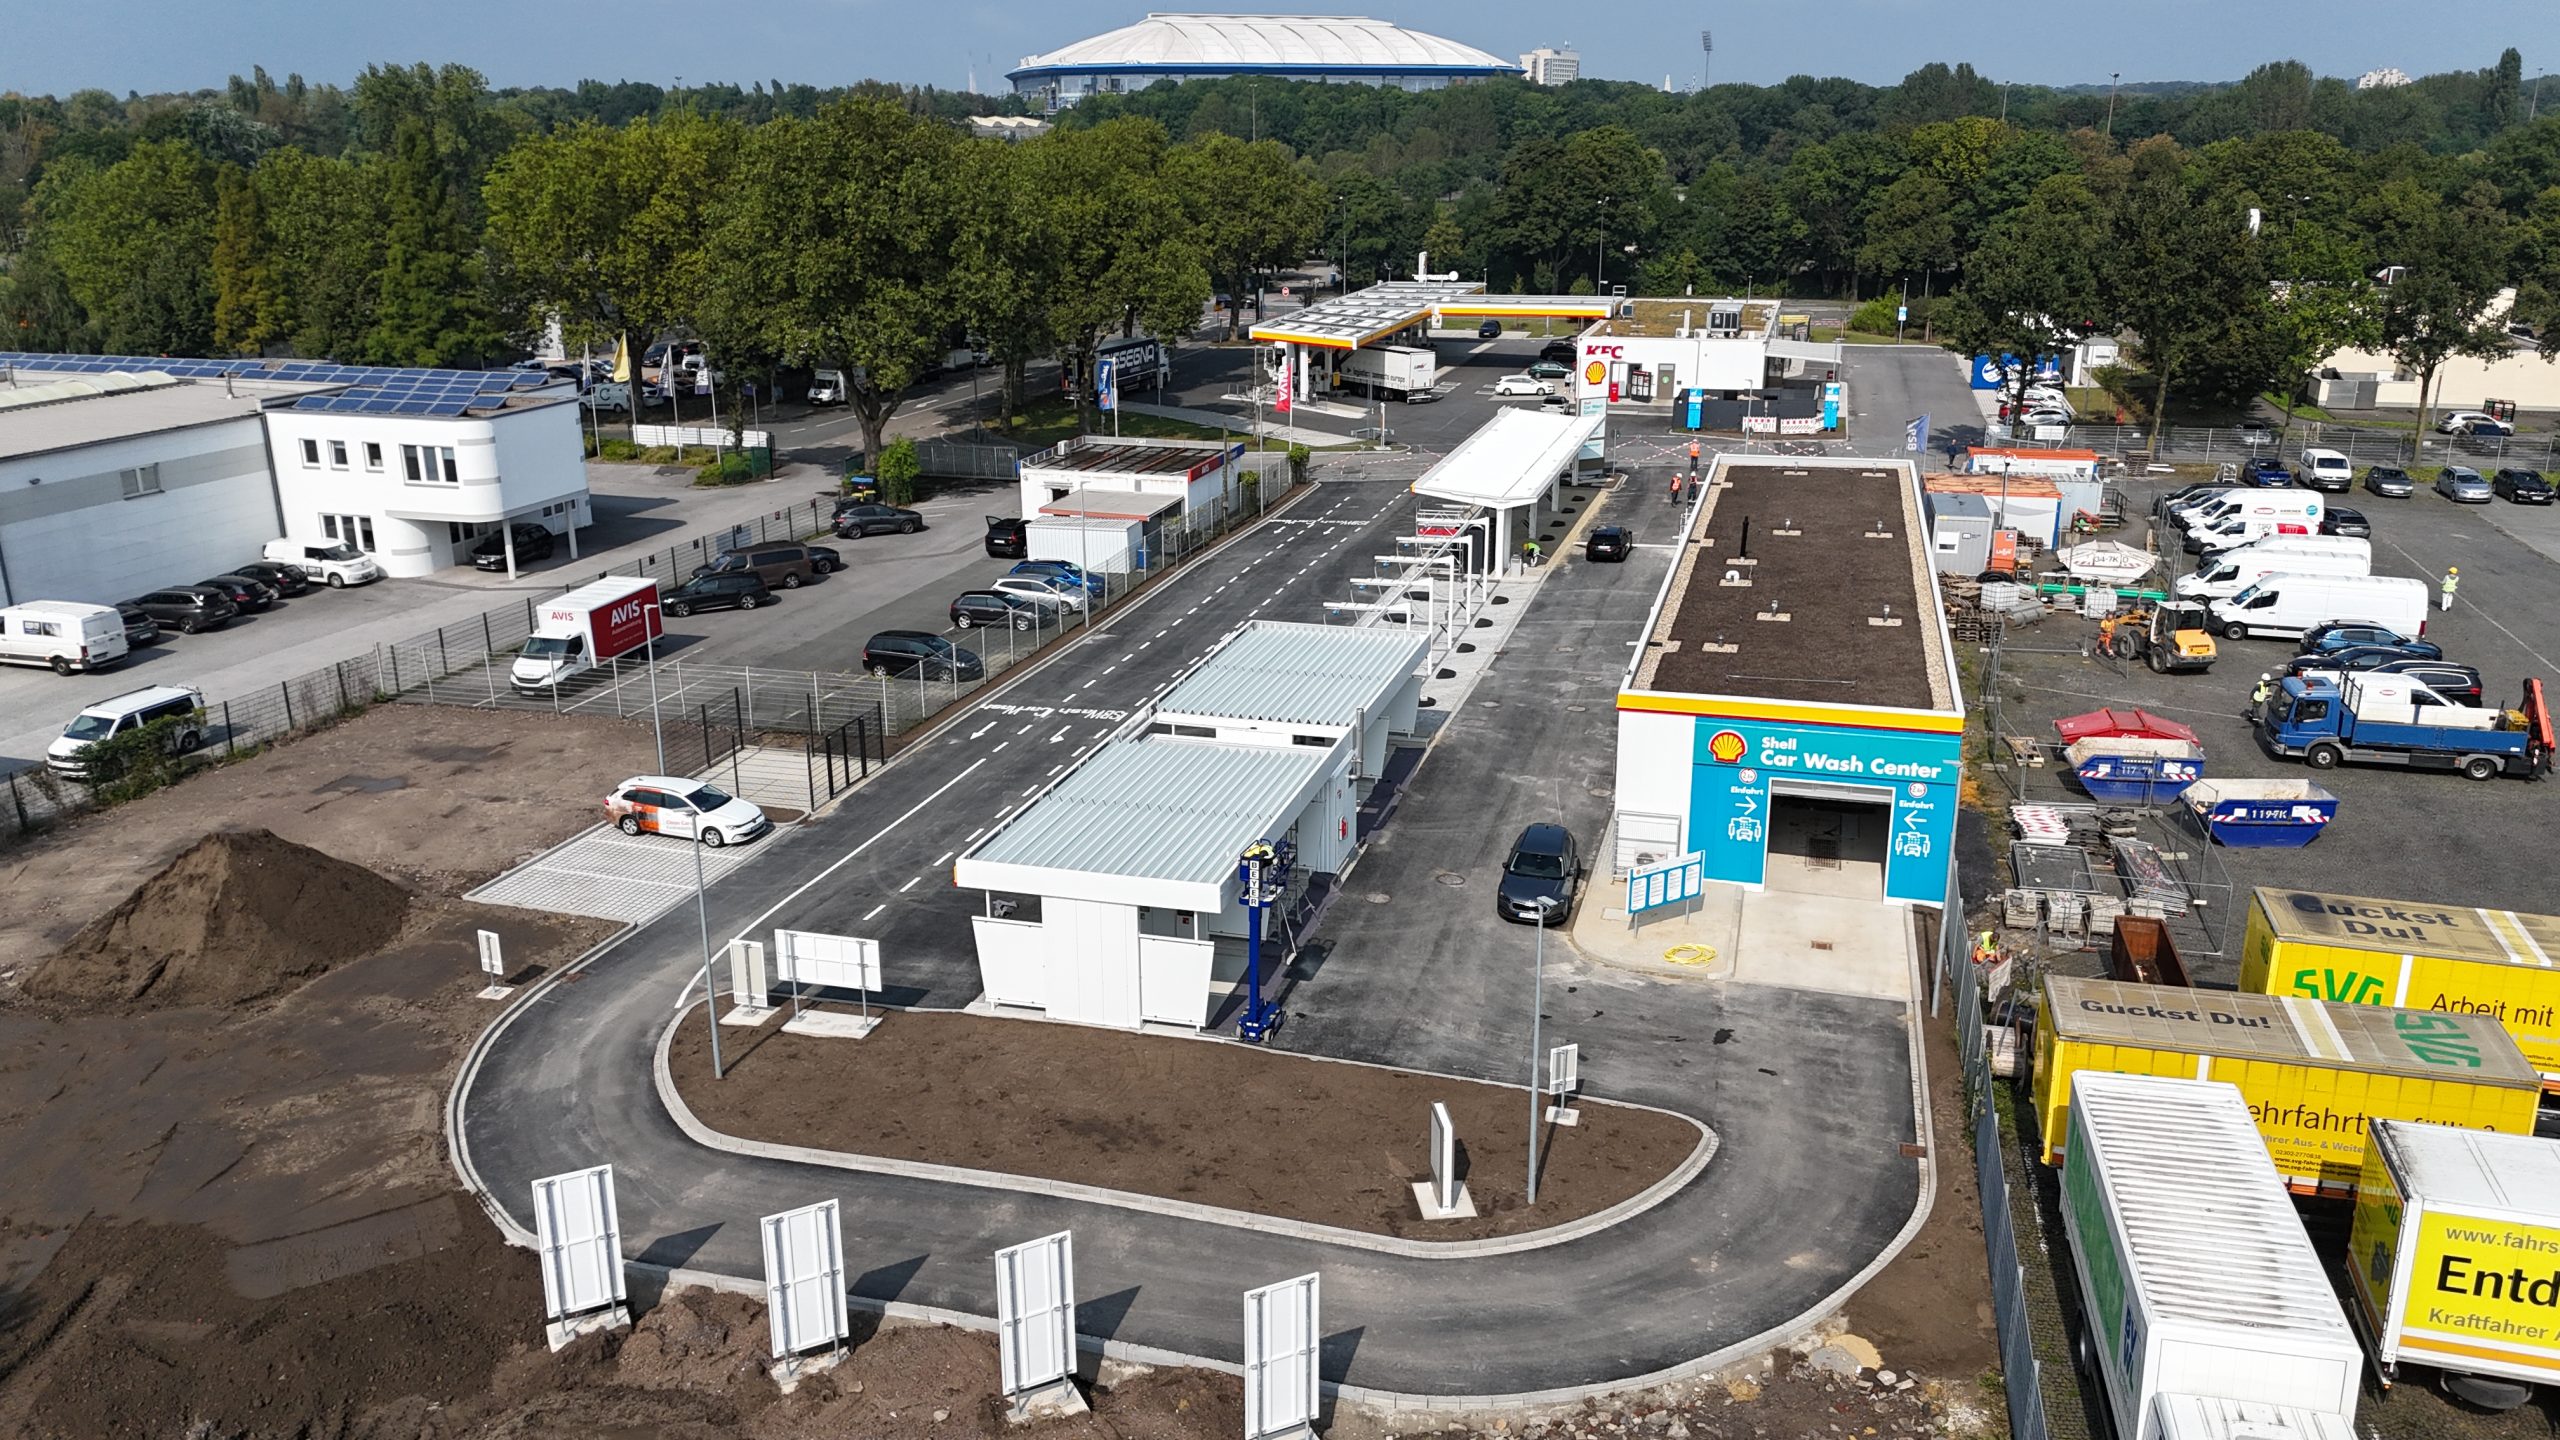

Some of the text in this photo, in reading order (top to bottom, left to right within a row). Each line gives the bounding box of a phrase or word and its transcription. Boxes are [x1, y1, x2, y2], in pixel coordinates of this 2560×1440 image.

[1102, 344, 1154, 370] SSEGNA
[1586, 345, 1624, 359] KFC
[551, 611, 574, 622] AVIS
[610, 599, 641, 628] AVIS
[1761, 736, 1797, 751] Shell
[1760, 750, 1941, 779] Car Wash Center
[1730, 786, 1764, 796] Einfahrt
[1899, 800, 1934, 810] Einfahrt
[2291, 893, 2459, 928] Guckst
[2344, 919, 2428, 941] Du!
[2293, 968, 2385, 1005] SVG
[2080, 1000, 2271, 1030] Guckst Du!
[2431, 993, 2554, 1027] Arbeit mit
[2394, 1013, 2481, 1067] SVG
[2248, 1100, 2365, 1135] ehrfahrt
[2293, 1137, 2317, 1147] Aus-
[2320, 1141, 2328, 1149] &
[2436, 1254, 2560, 1307] Entd
[2428, 1308, 2549, 1341] Kraftfahrer
